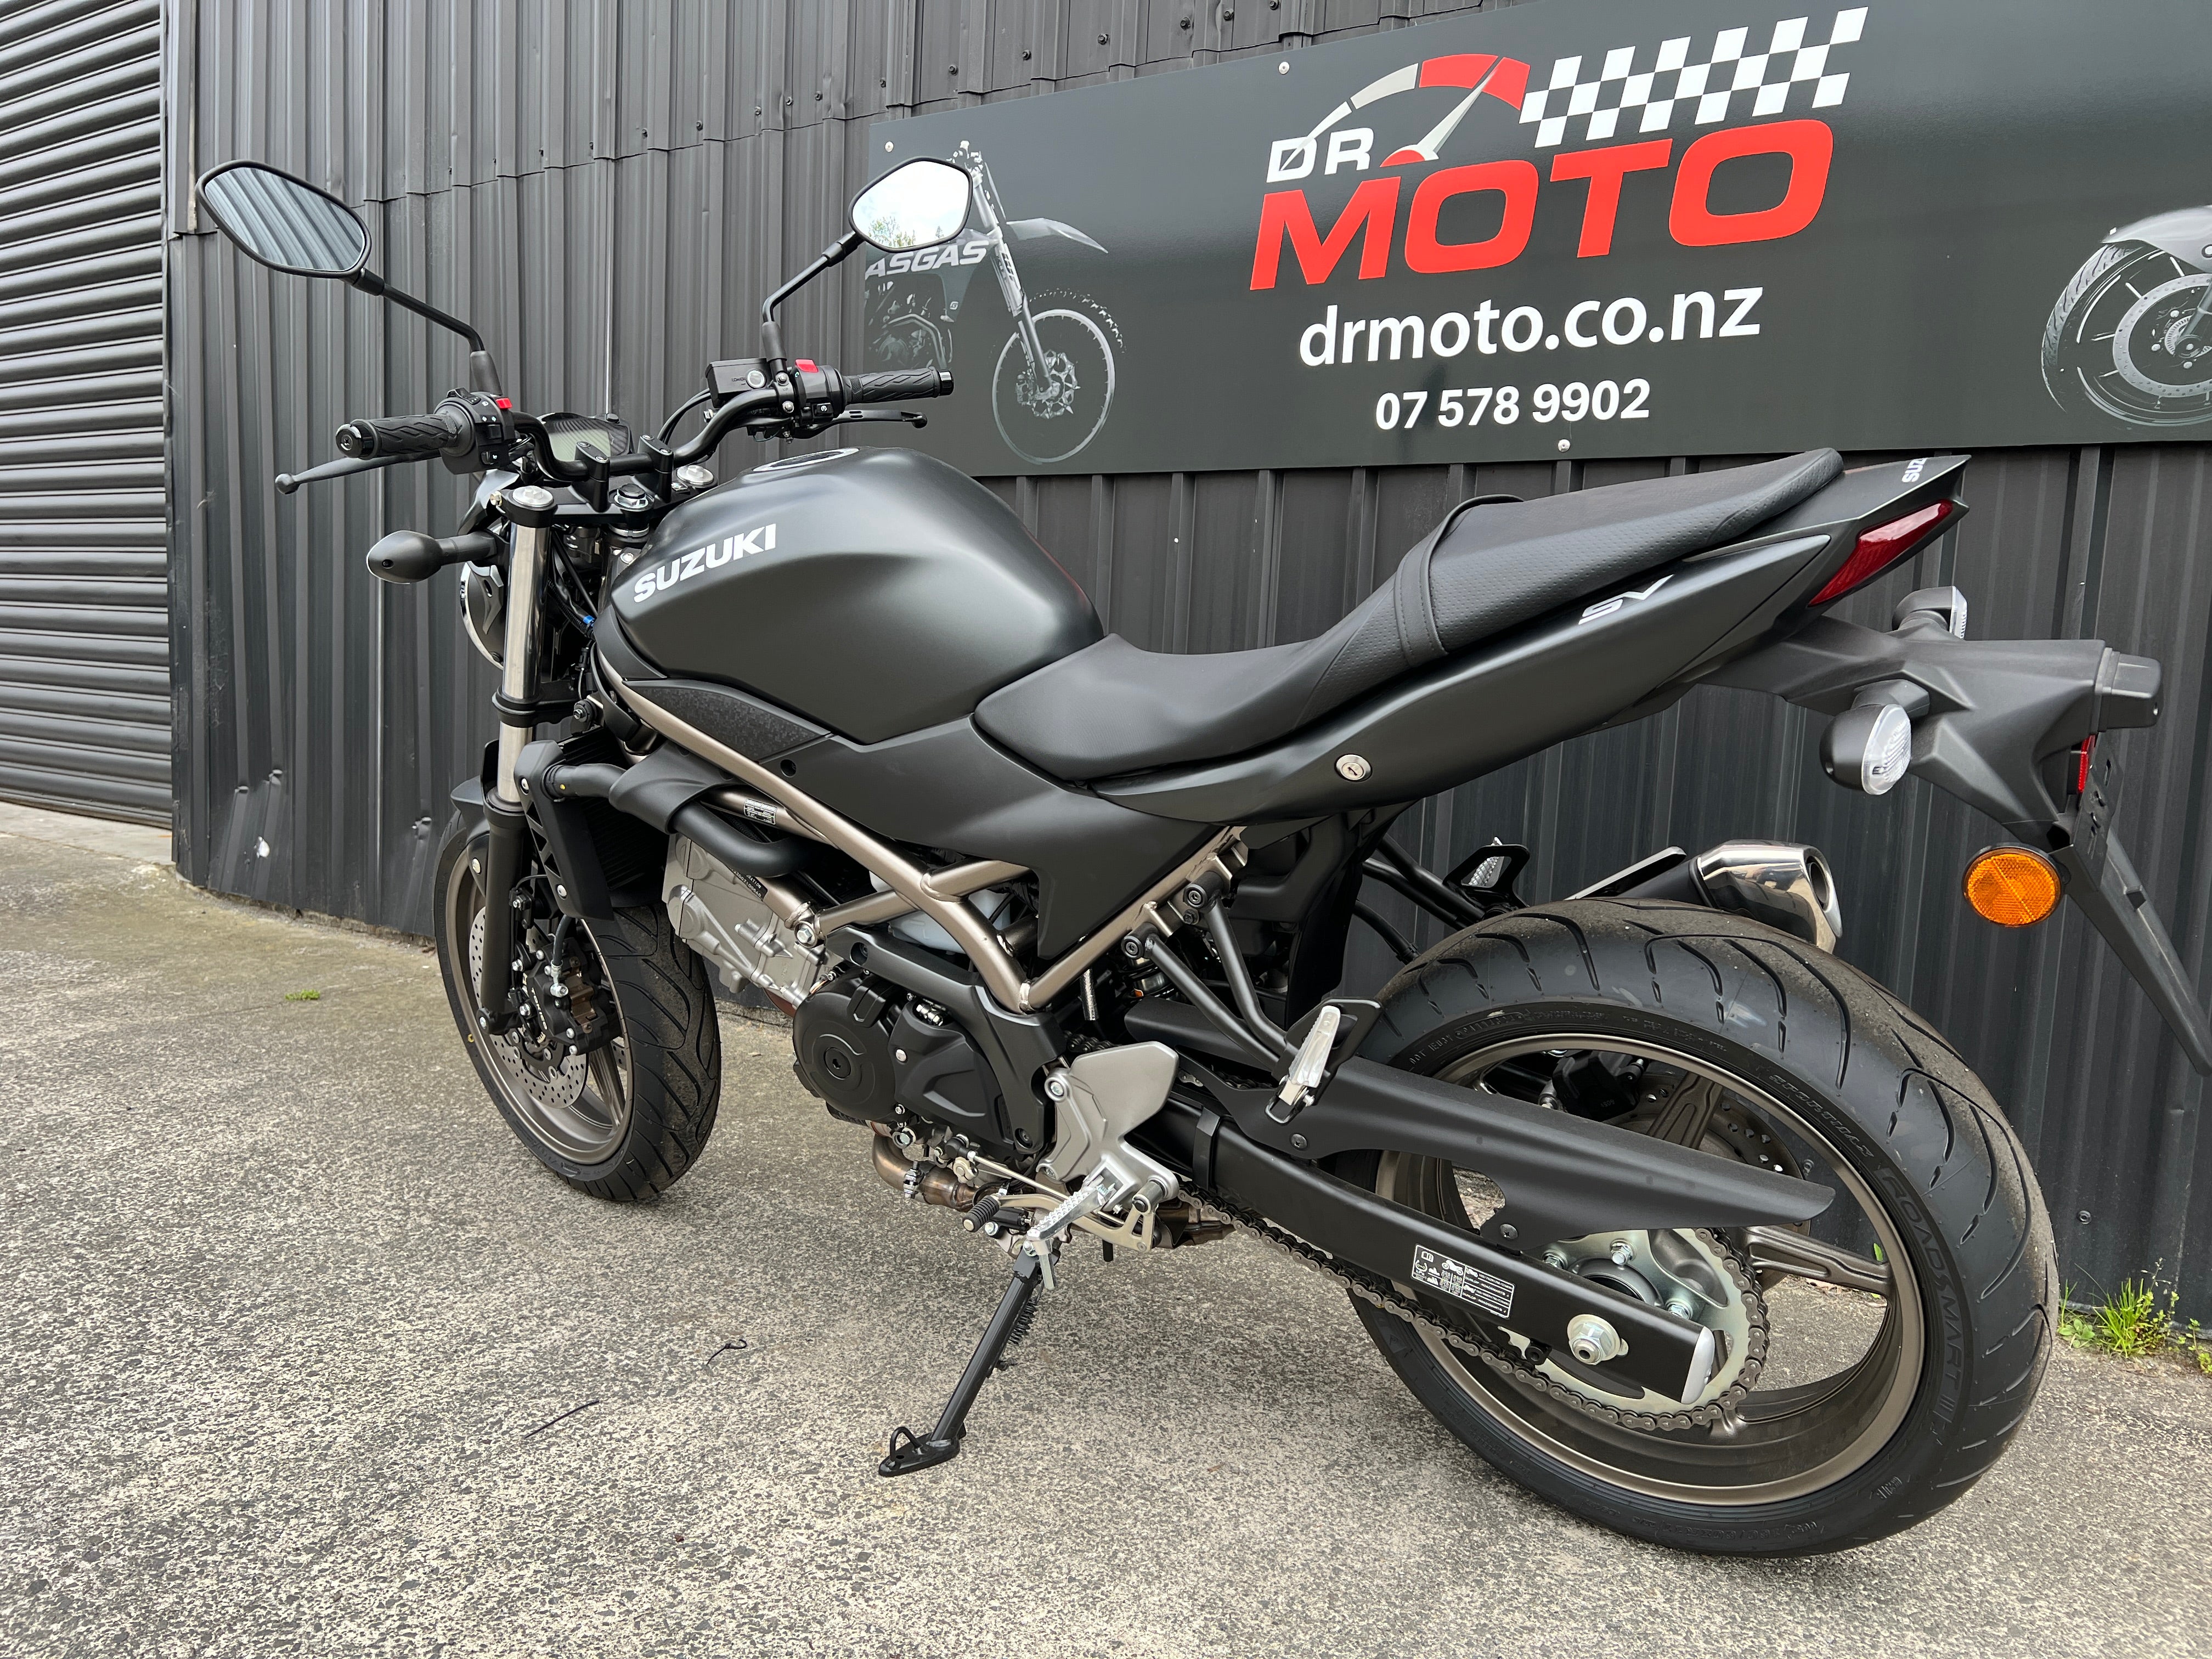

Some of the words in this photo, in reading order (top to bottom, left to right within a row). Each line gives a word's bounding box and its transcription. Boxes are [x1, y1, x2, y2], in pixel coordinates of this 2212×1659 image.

[1266, 127, 1374, 183] DR
[1250, 119, 1834, 291] MOTO
[1300, 286, 1764, 366] drmoto.co.nz
[1375, 391, 1428, 430] 07
[1438, 386, 1520, 427] 578
[1532, 378, 1650, 423] 9902
[633, 523, 777, 603] SUZUKI
[1578, 574, 1674, 625] SV
[1882, 1176, 1964, 1390] ROADSMART
